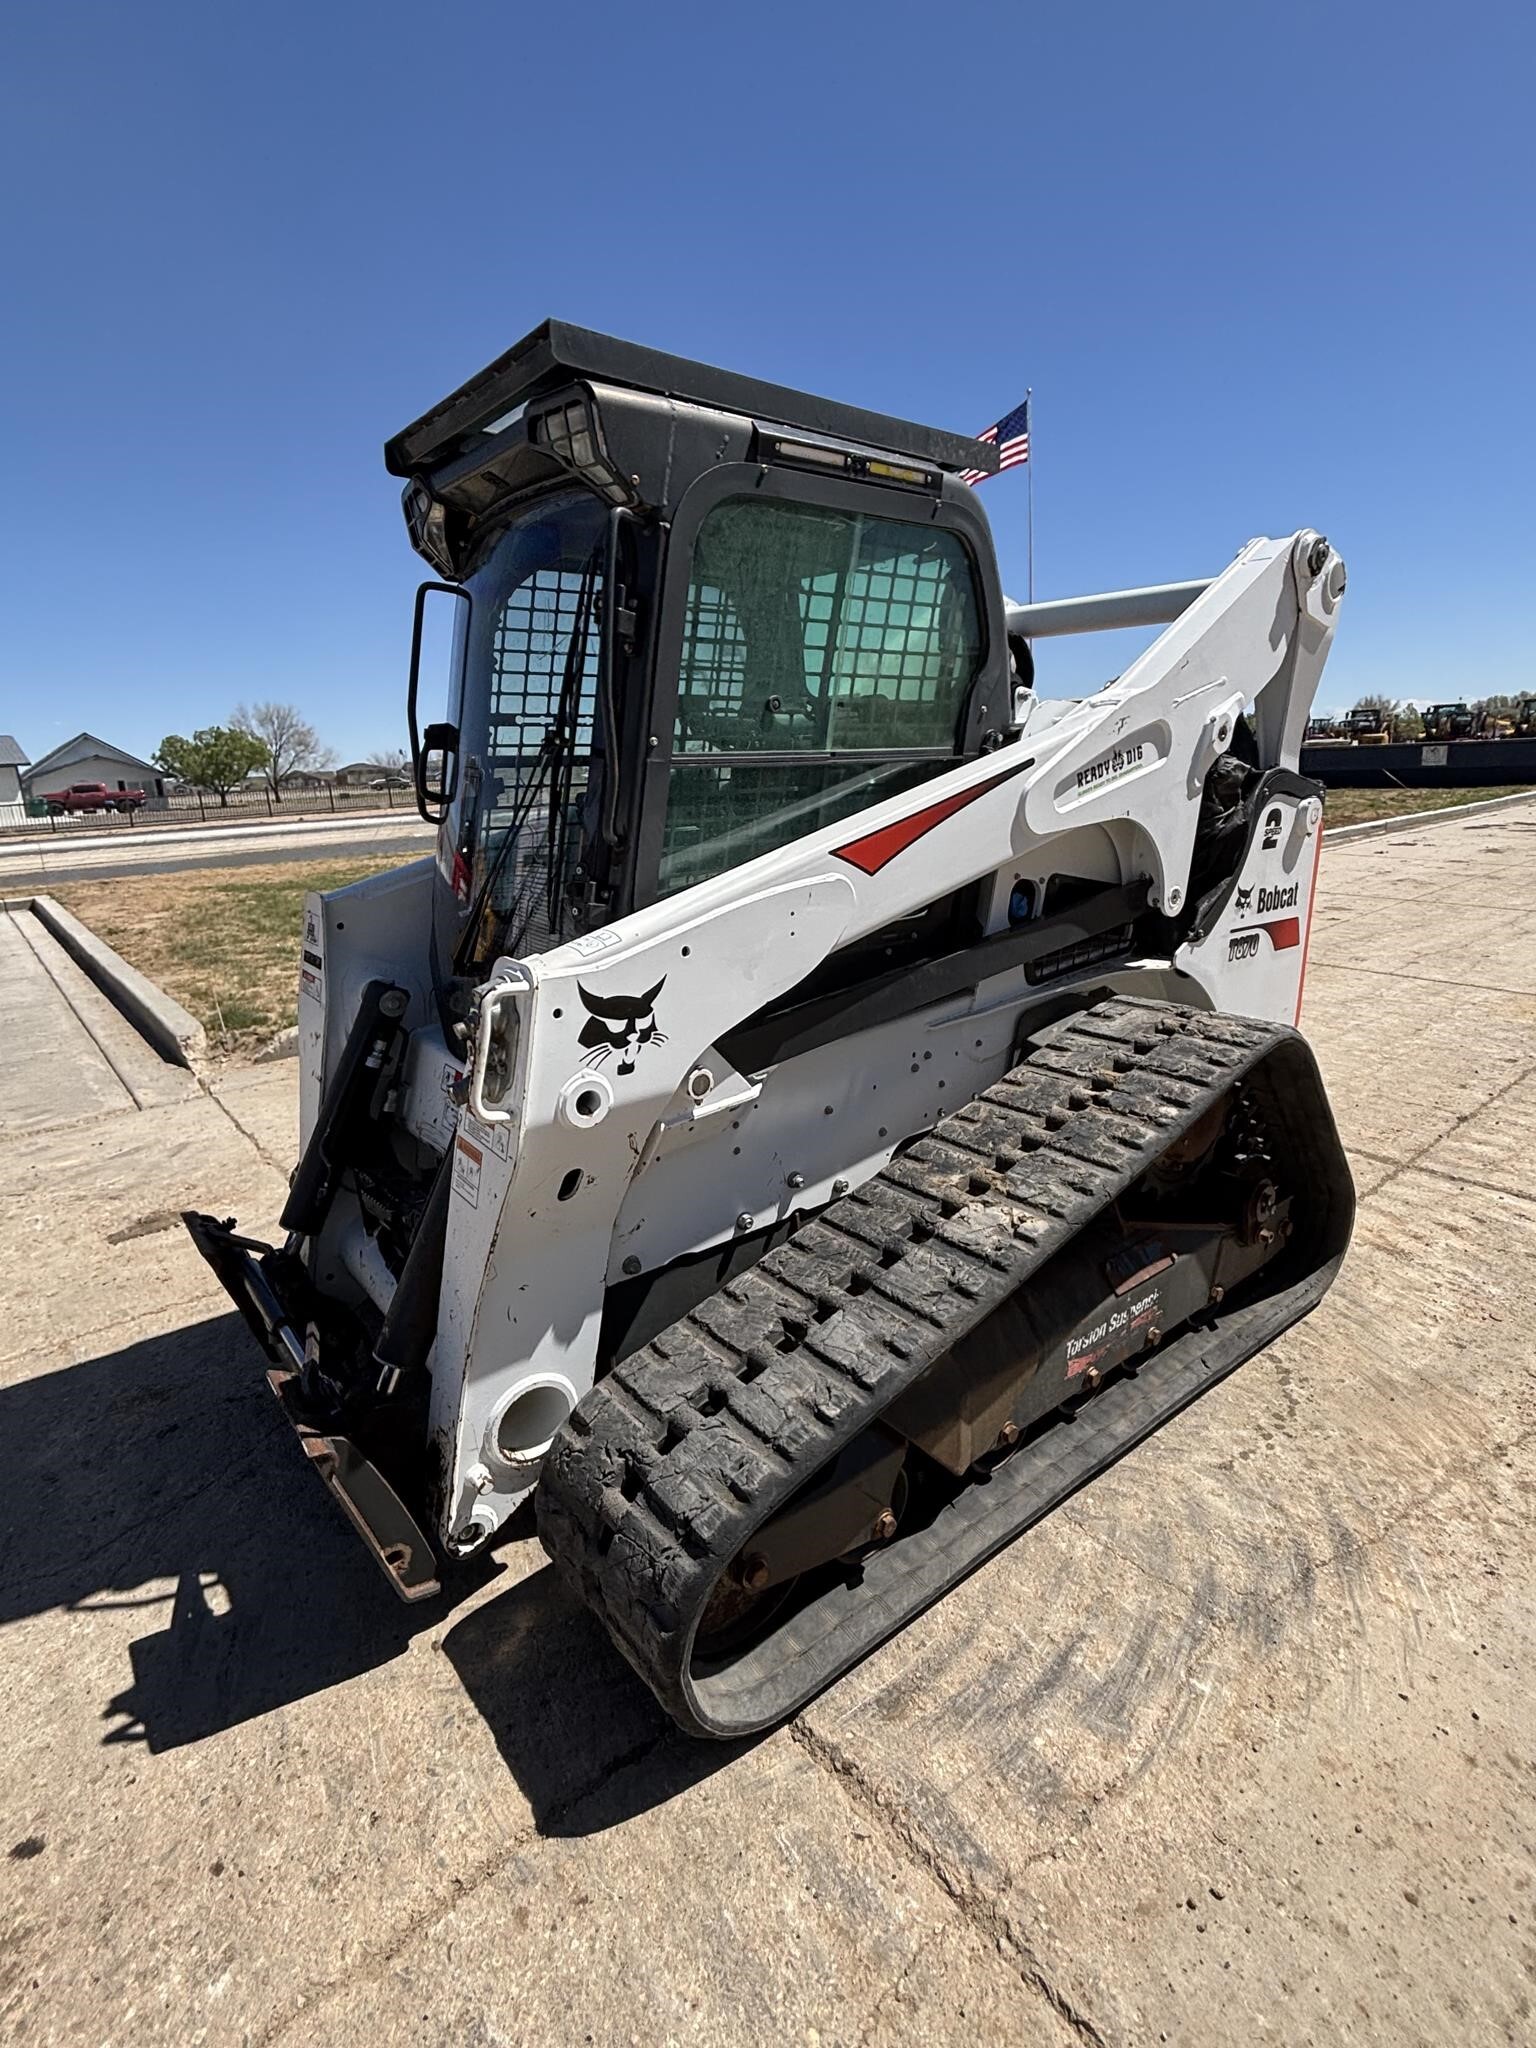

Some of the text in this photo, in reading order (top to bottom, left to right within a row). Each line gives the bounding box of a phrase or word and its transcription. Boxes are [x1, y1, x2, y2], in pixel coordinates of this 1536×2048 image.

[1076, 759, 1110, 789] READY
[1126, 745, 1143, 765] DIG
[1257, 882, 1299, 914] Bobcat
[1228, 933, 1260, 962] T870
[1066, 1322, 1108, 1358] Torsion
